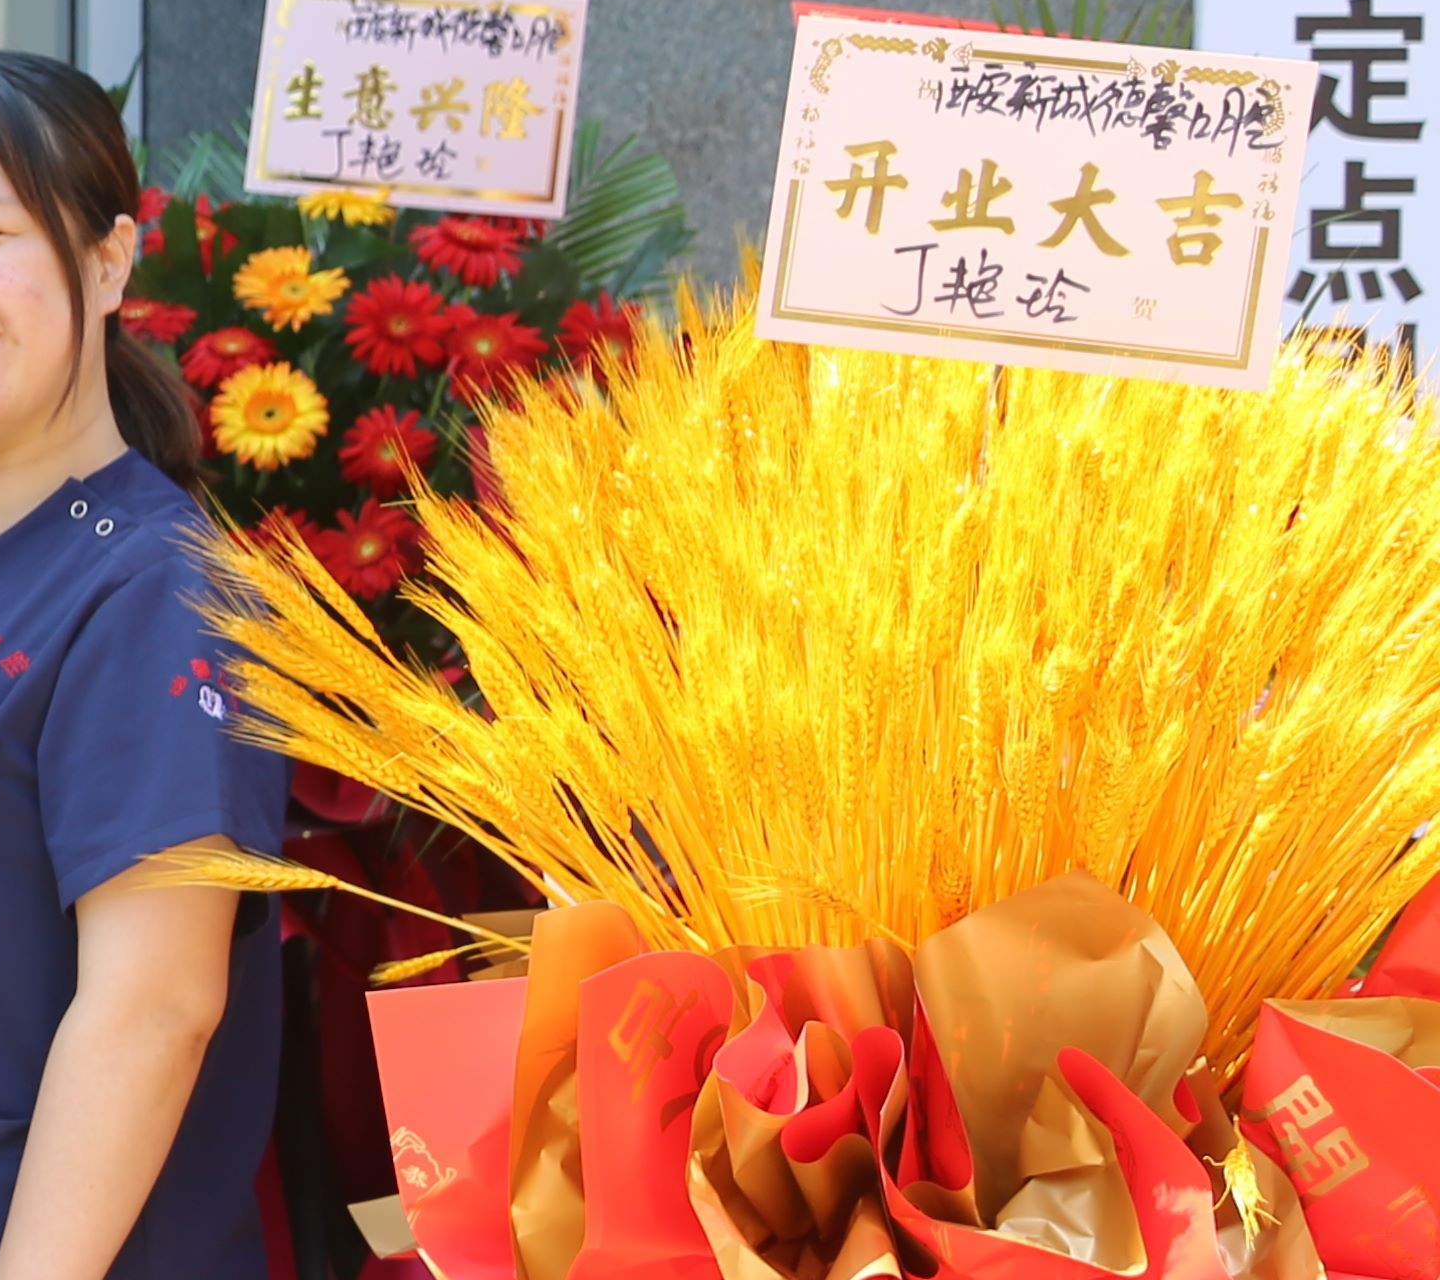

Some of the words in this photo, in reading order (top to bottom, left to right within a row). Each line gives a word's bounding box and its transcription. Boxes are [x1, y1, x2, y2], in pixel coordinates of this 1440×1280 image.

[283, 58, 546, 140] 生意兴隆
[823, 138, 1245, 267] 开业大吉
